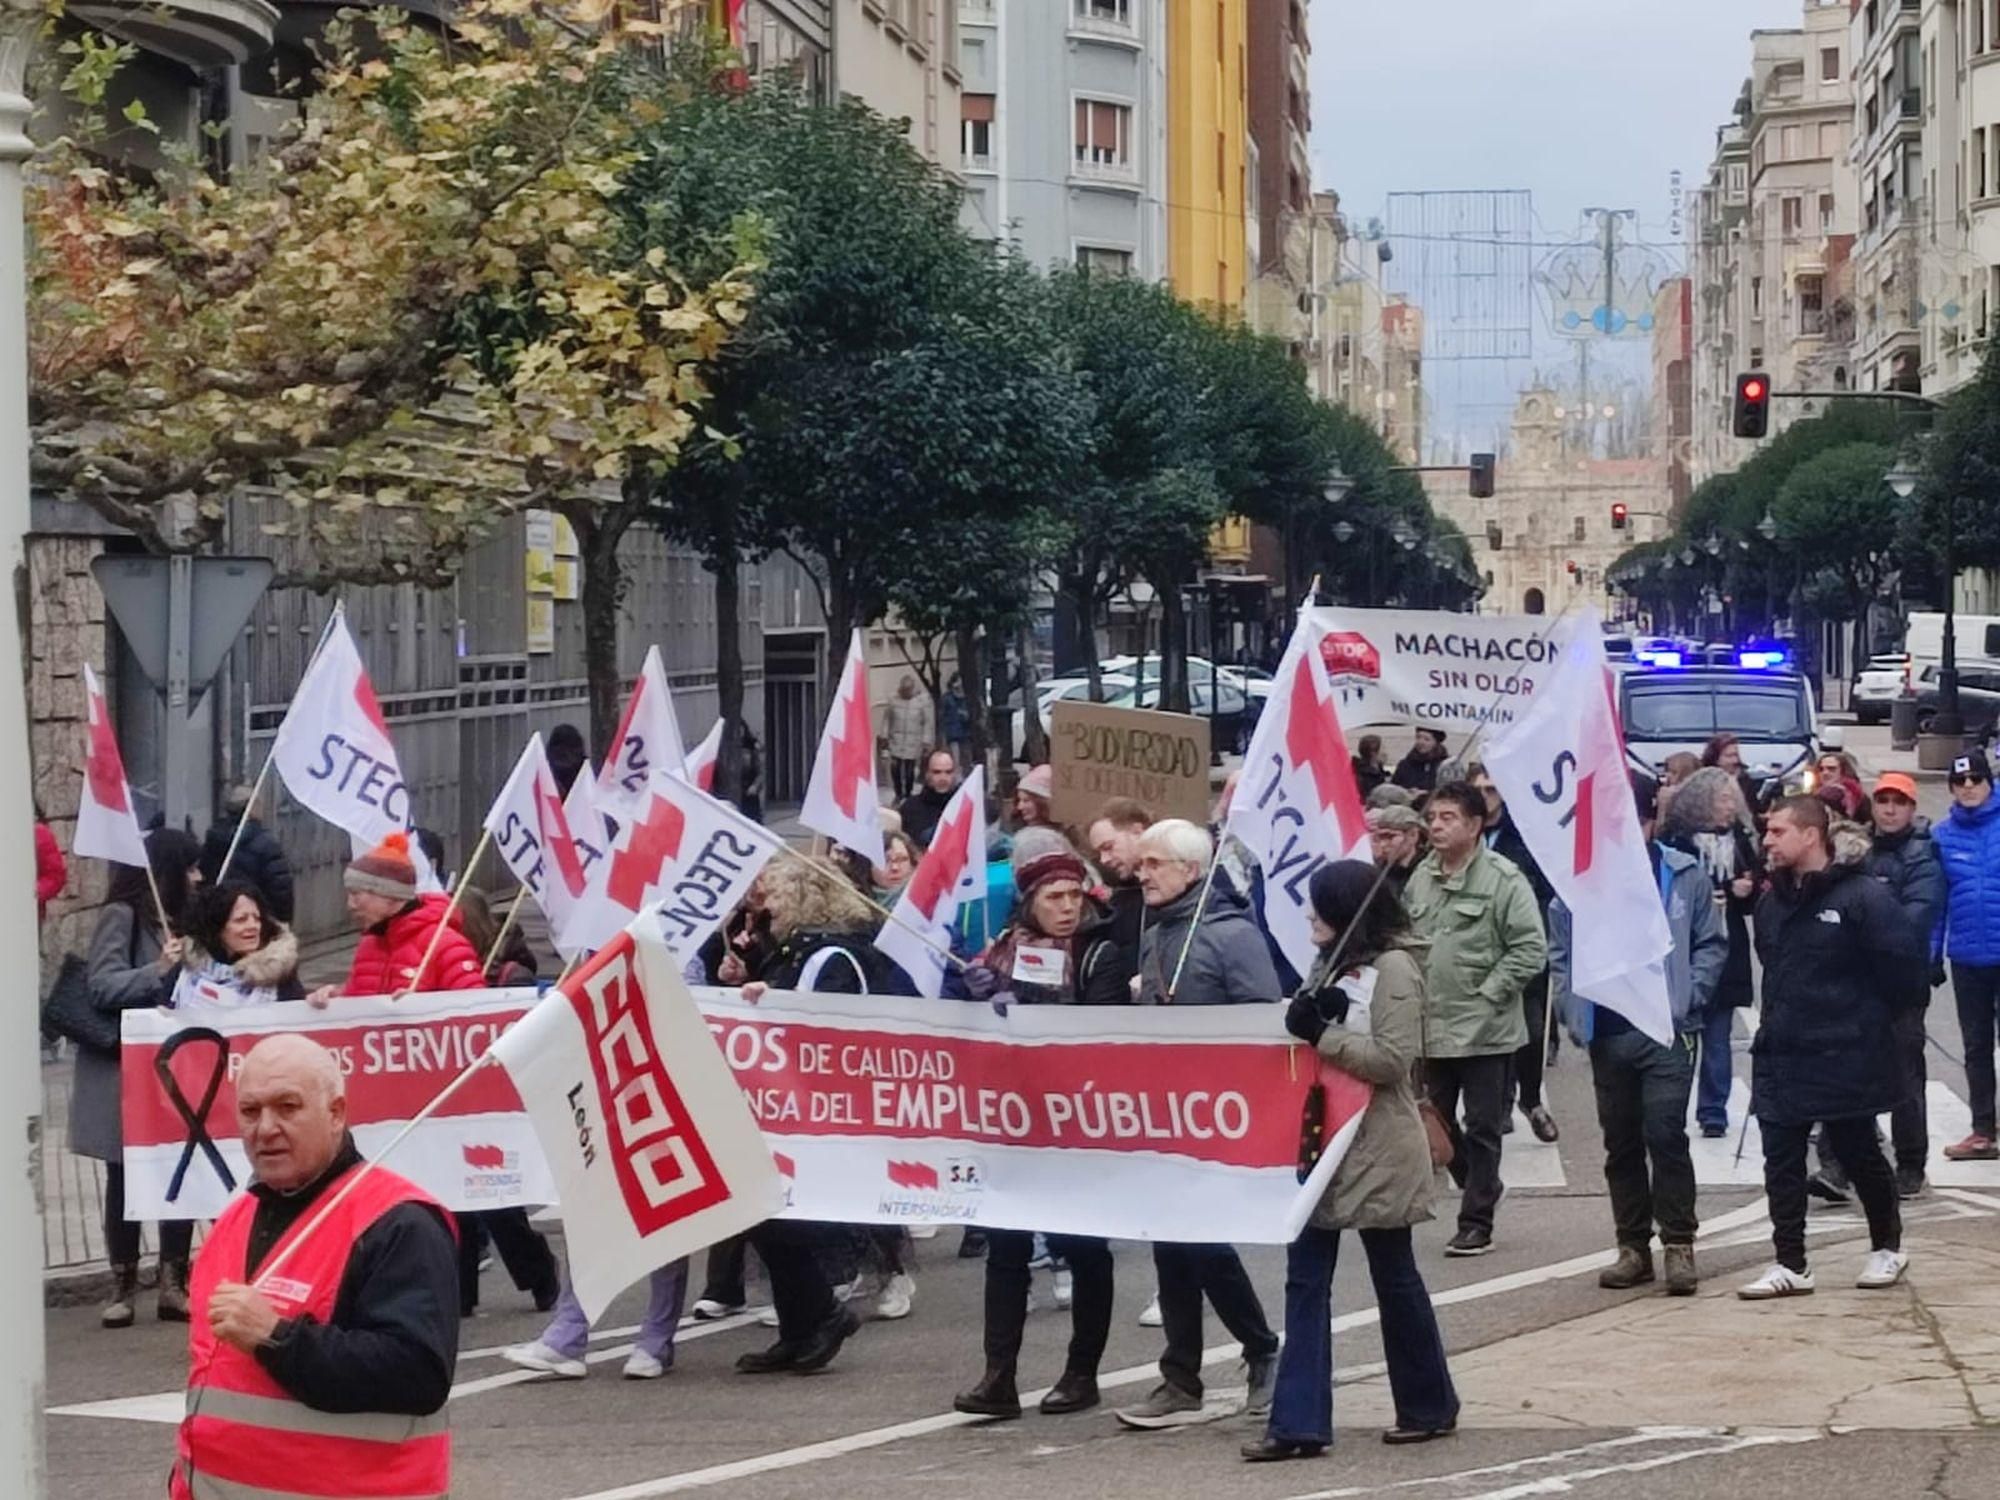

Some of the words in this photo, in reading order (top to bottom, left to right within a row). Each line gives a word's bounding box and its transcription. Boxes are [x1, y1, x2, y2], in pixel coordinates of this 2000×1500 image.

[1323, 641, 1370, 659] STOP
[1429, 669, 1468, 690] SIN
[1475, 672, 1535, 697] OLOR
[583, 952, 706, 1210] CCOO
[799, 1043, 833, 1075] DE
[840, 1045, 955, 1081] CALIDAD
[566, 1080, 597, 1170] León
[809, 1091, 862, 1124] DEL
[872, 1081, 1031, 1138] EMPLEO
[1043, 1080, 1250, 1140] PÚBLICO
